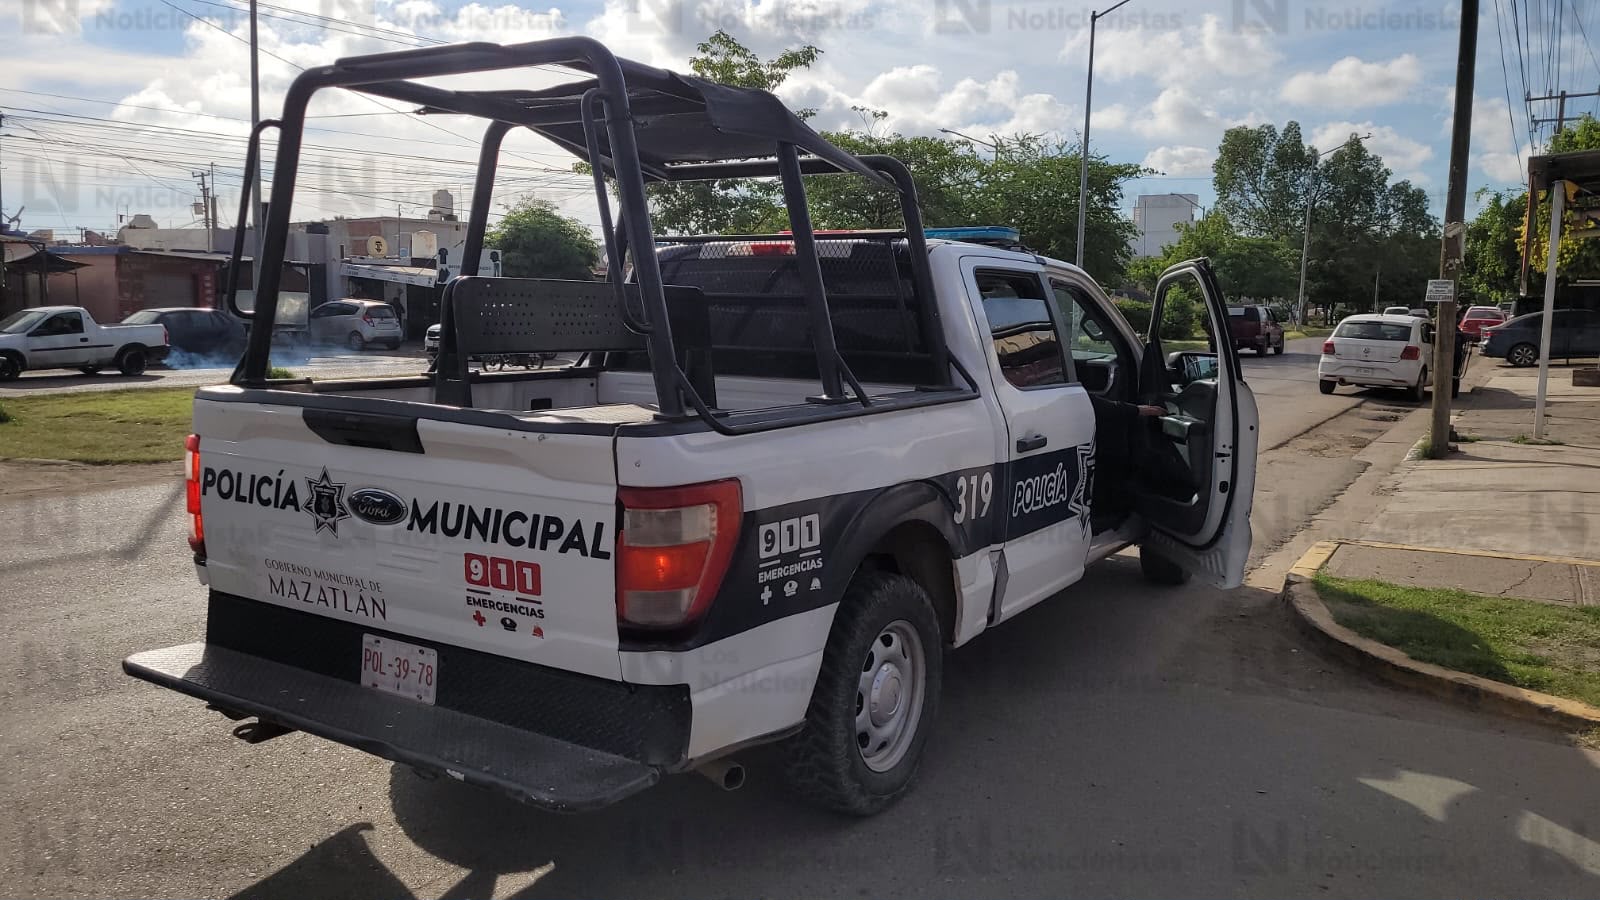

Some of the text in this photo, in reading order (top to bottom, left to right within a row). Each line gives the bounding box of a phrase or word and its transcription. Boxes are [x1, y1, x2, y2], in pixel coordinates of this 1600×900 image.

[358, 495, 392, 518] Ford
[953, 471, 993, 525] 319
[1013, 462, 1067, 517] POLICÍA
[202, 467, 611, 560] POLICÍA MUNICIPAL
[762, 517, 816, 555] 911
[265, 558, 383, 593] GOBIERNO MUNICIPAL DE
[467, 556, 537, 593] 911
[758, 558, 823, 583] EMERGENCIAS
[268, 575, 387, 620] MAZATLÁN
[466, 596, 544, 619] EMERGENCIAS
[363, 647, 433, 687] POL-39-78
